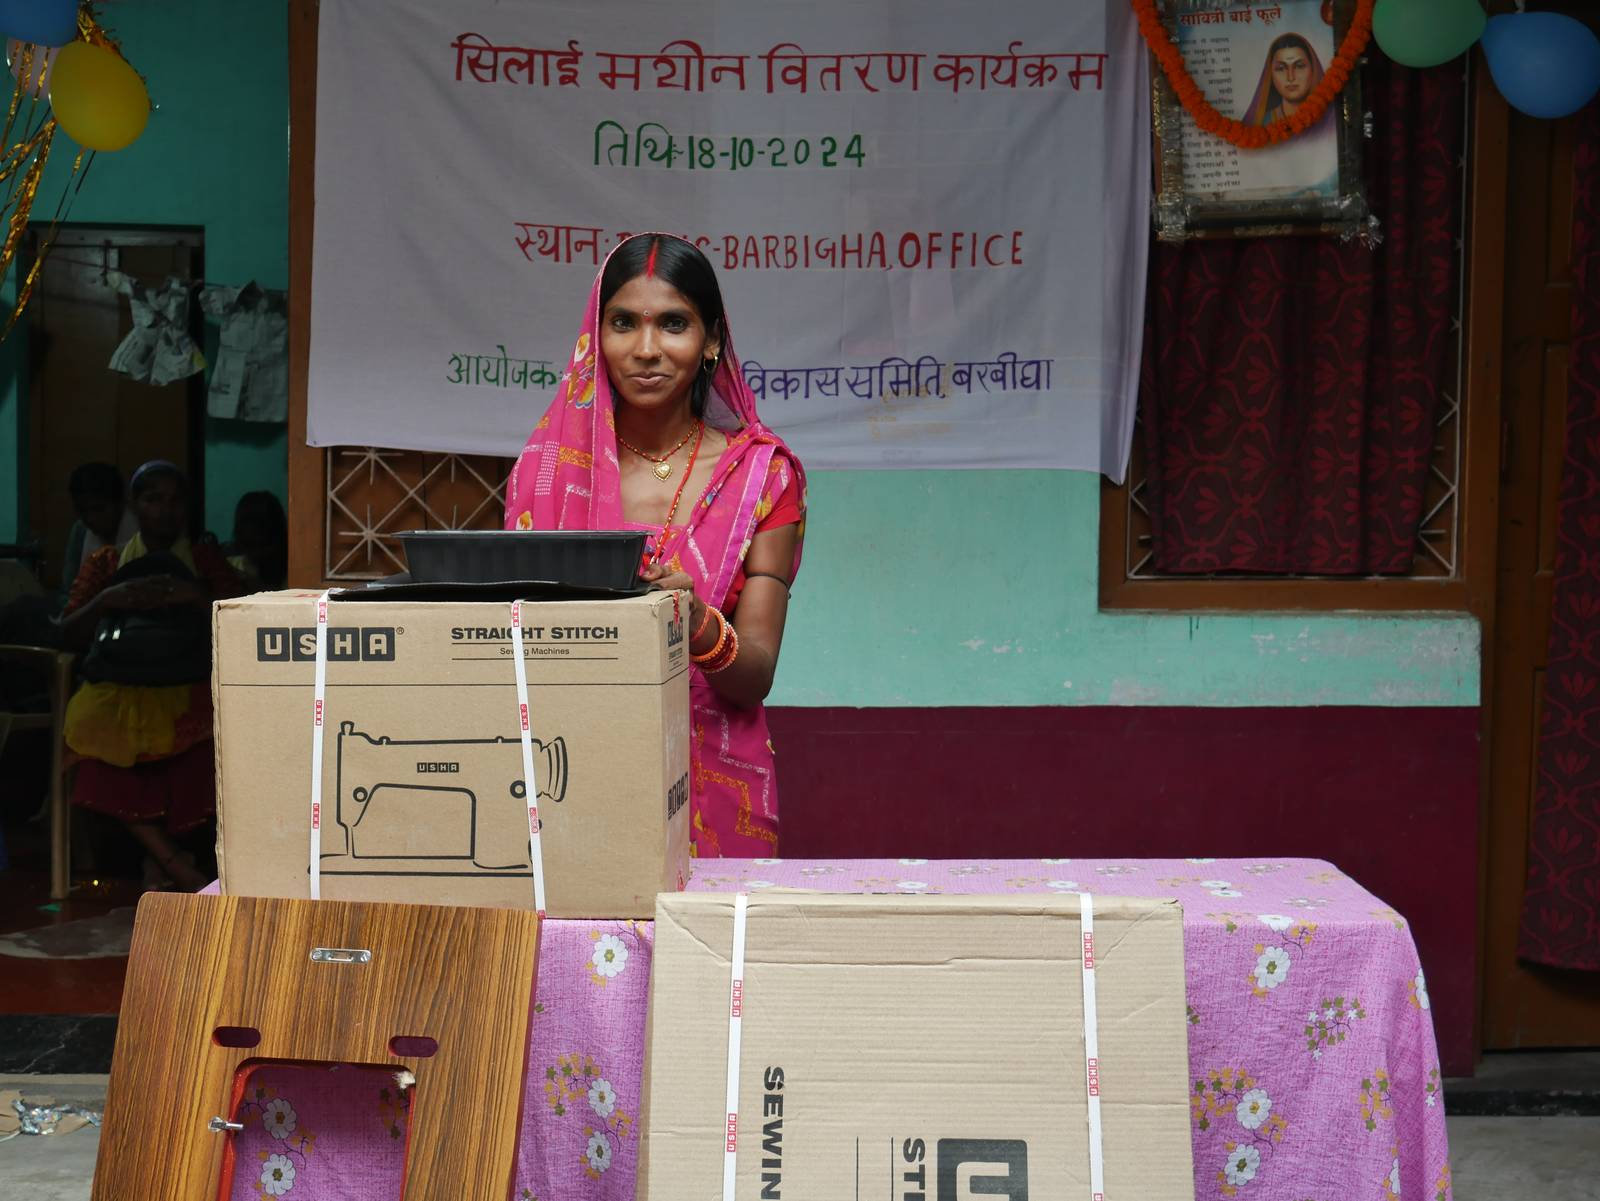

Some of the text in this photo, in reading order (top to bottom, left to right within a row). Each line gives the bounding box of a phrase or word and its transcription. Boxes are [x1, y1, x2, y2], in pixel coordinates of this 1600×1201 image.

[451, 33, 1109, 93] सिलाई मशीन वितरण कार्यक्रम
[261, 629, 391, 659] USHA
[551, 626, 618, 639] STITCH
[531, 647, 570, 656] Machines
[417, 762, 459, 773] USHA
[1084, 932, 1093, 969] USHA
[732, 979, 742, 1017] USHA
[1088, 1058, 1098, 1096] USHA
[727, 1113, 736, 1152] USHA
[903, 1138, 926, 1201] ST
